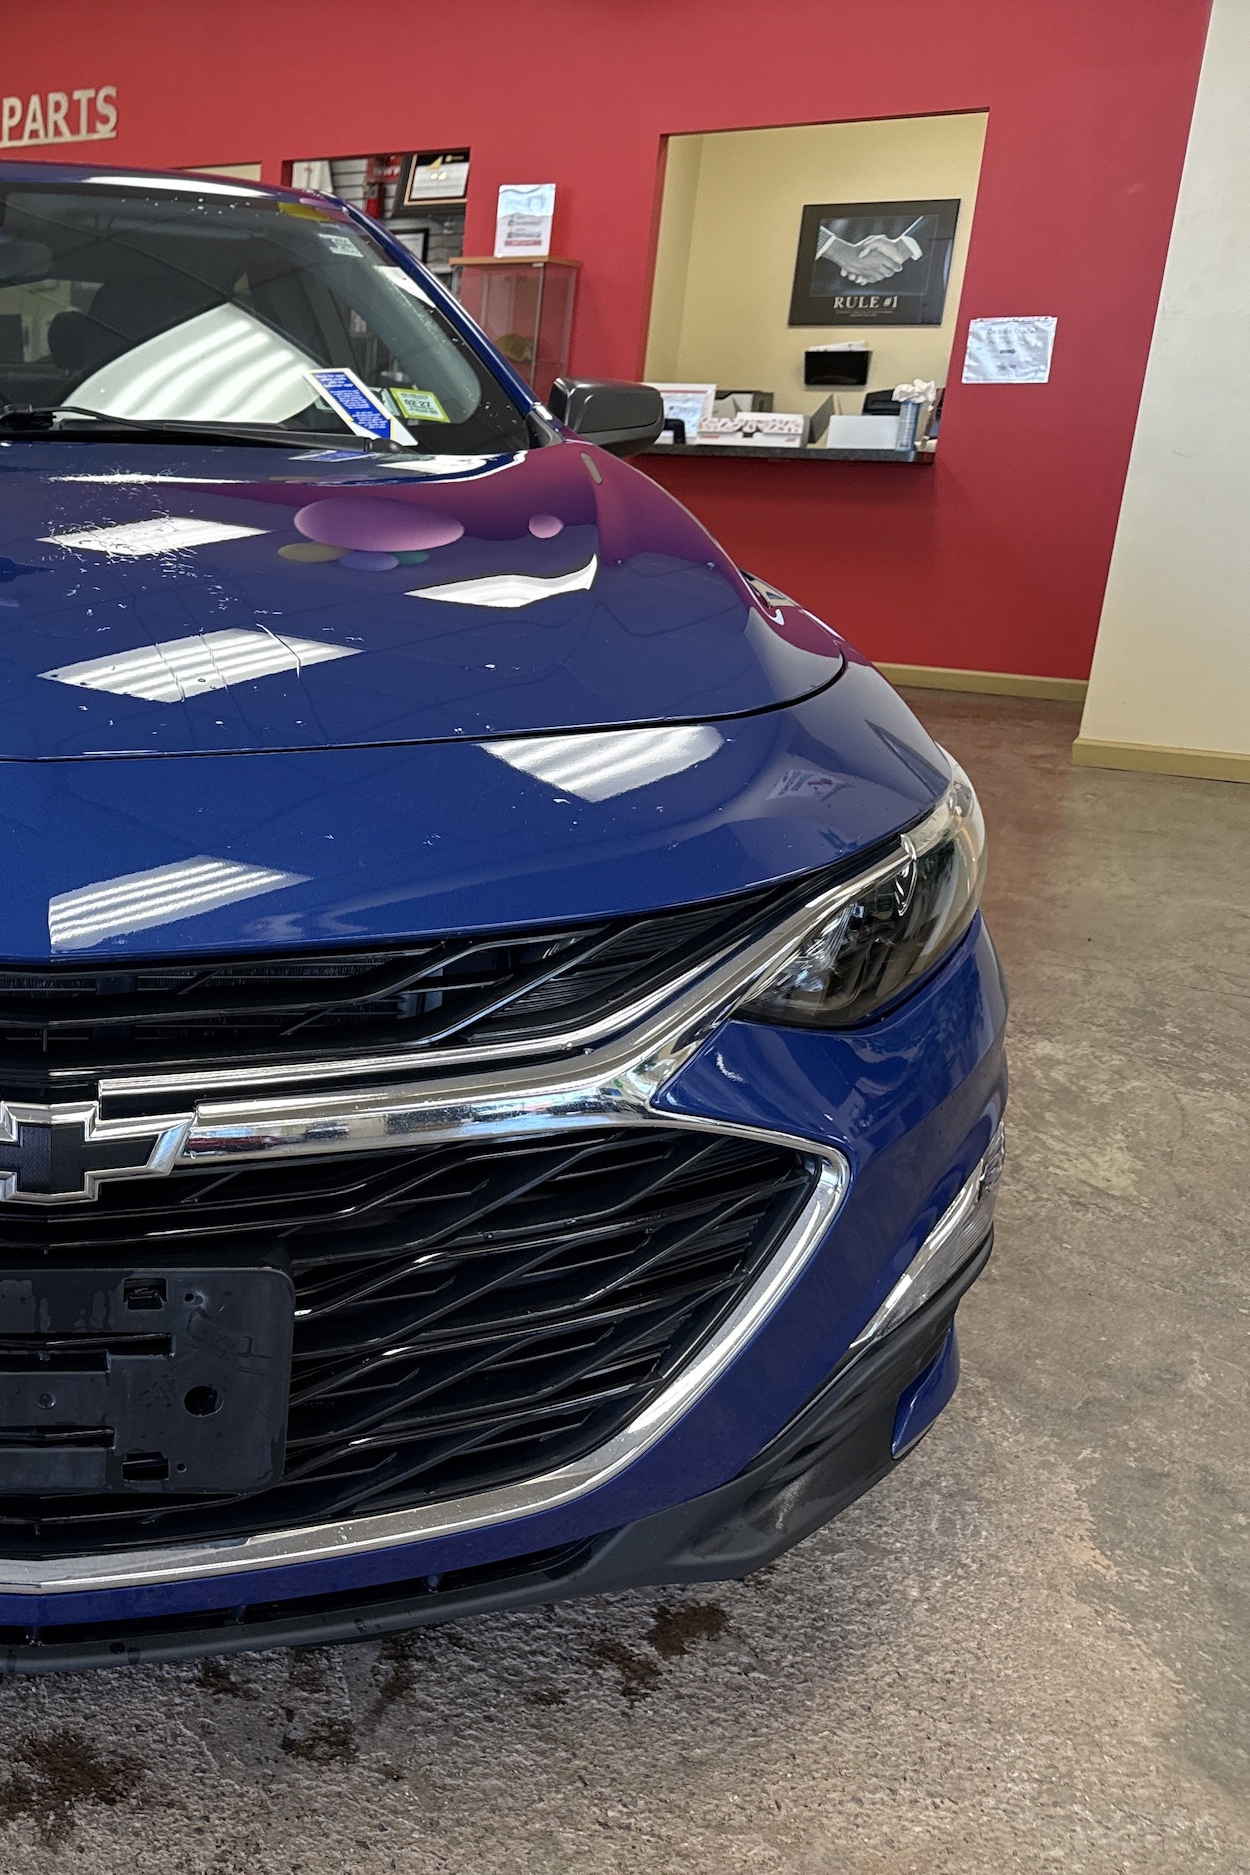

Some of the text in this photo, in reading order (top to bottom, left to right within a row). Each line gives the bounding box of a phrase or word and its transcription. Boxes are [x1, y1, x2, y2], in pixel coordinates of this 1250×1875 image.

[0, 85, 118, 144] PARTS
[833, 295, 899, 309] RULE #1
